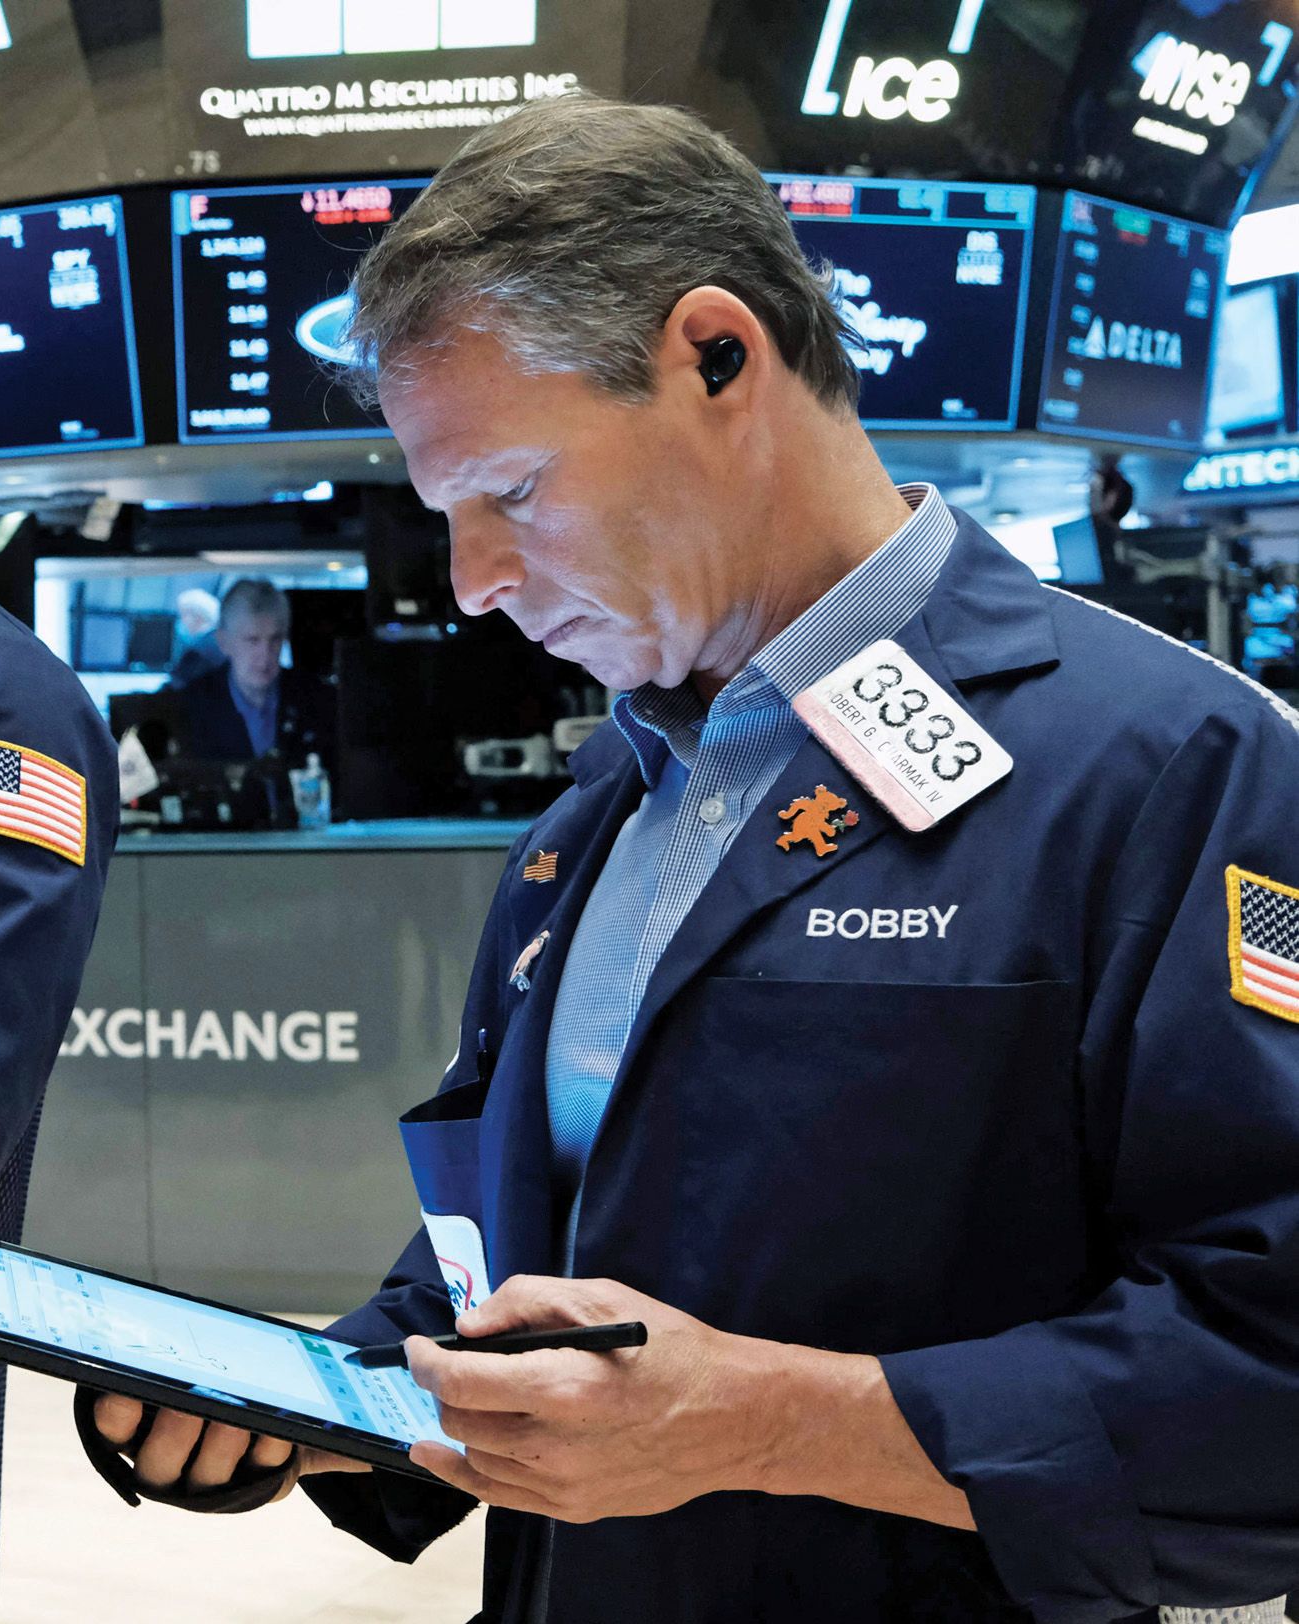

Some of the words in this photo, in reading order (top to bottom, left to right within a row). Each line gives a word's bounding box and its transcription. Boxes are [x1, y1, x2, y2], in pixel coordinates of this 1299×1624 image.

[335, 81, 364, 109] M
[828, 690, 867, 727] OBERT
[853, 664, 982, 781] 3333
[806, 904, 959, 939] BOBBY
